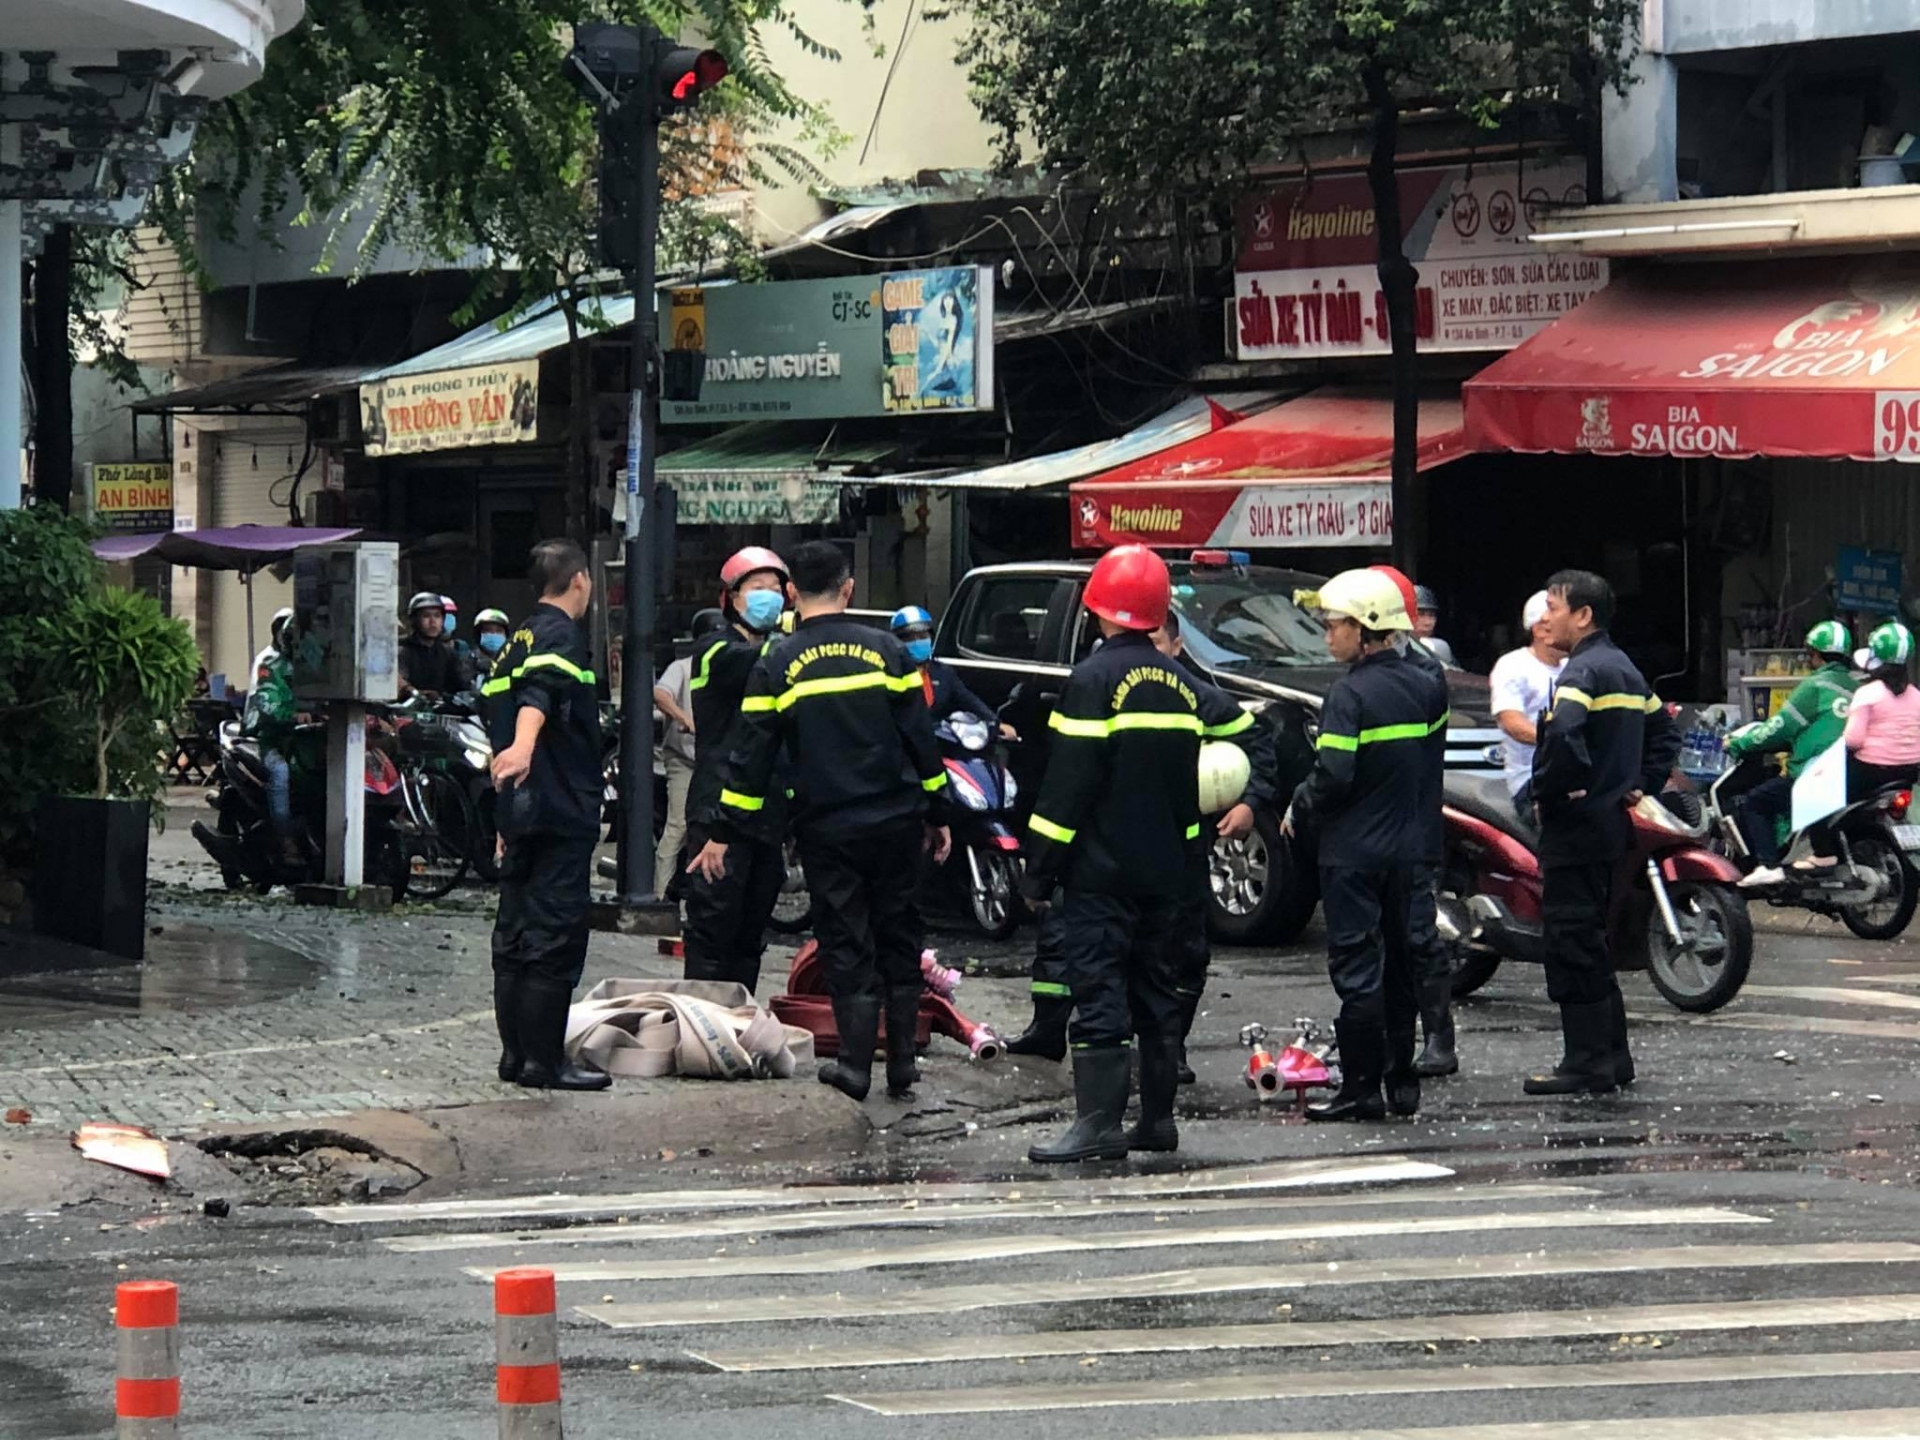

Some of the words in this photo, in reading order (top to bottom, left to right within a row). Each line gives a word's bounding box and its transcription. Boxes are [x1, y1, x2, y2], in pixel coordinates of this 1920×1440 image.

[1287, 204, 1376, 240] Havoline
[883, 277, 925, 311] GAME
[1443, 298, 1455, 317] XE
[1547, 294, 1561, 312] XE
[1274, 295, 1299, 345] XE
[1796, 329, 1864, 350] BIA
[704, 350, 765, 382] HOÀNG
[769, 341, 841, 378] NGUYỄN
[1679, 345, 1910, 378] SAIGON
[411, 379, 462, 395] PHONG
[387, 396, 462, 433] TRƯỜNG
[468, 389, 506, 426] VÂN
[1668, 406, 1701, 423] BIA
[1631, 423, 1737, 451] SAIGON
[98, 489, 122, 509] AN
[128, 484, 169, 507] BÌNH
[1110, 504, 1183, 532] Havoline
[1278, 505, 1293, 536] XE
[1358, 502, 1366, 536] 8
